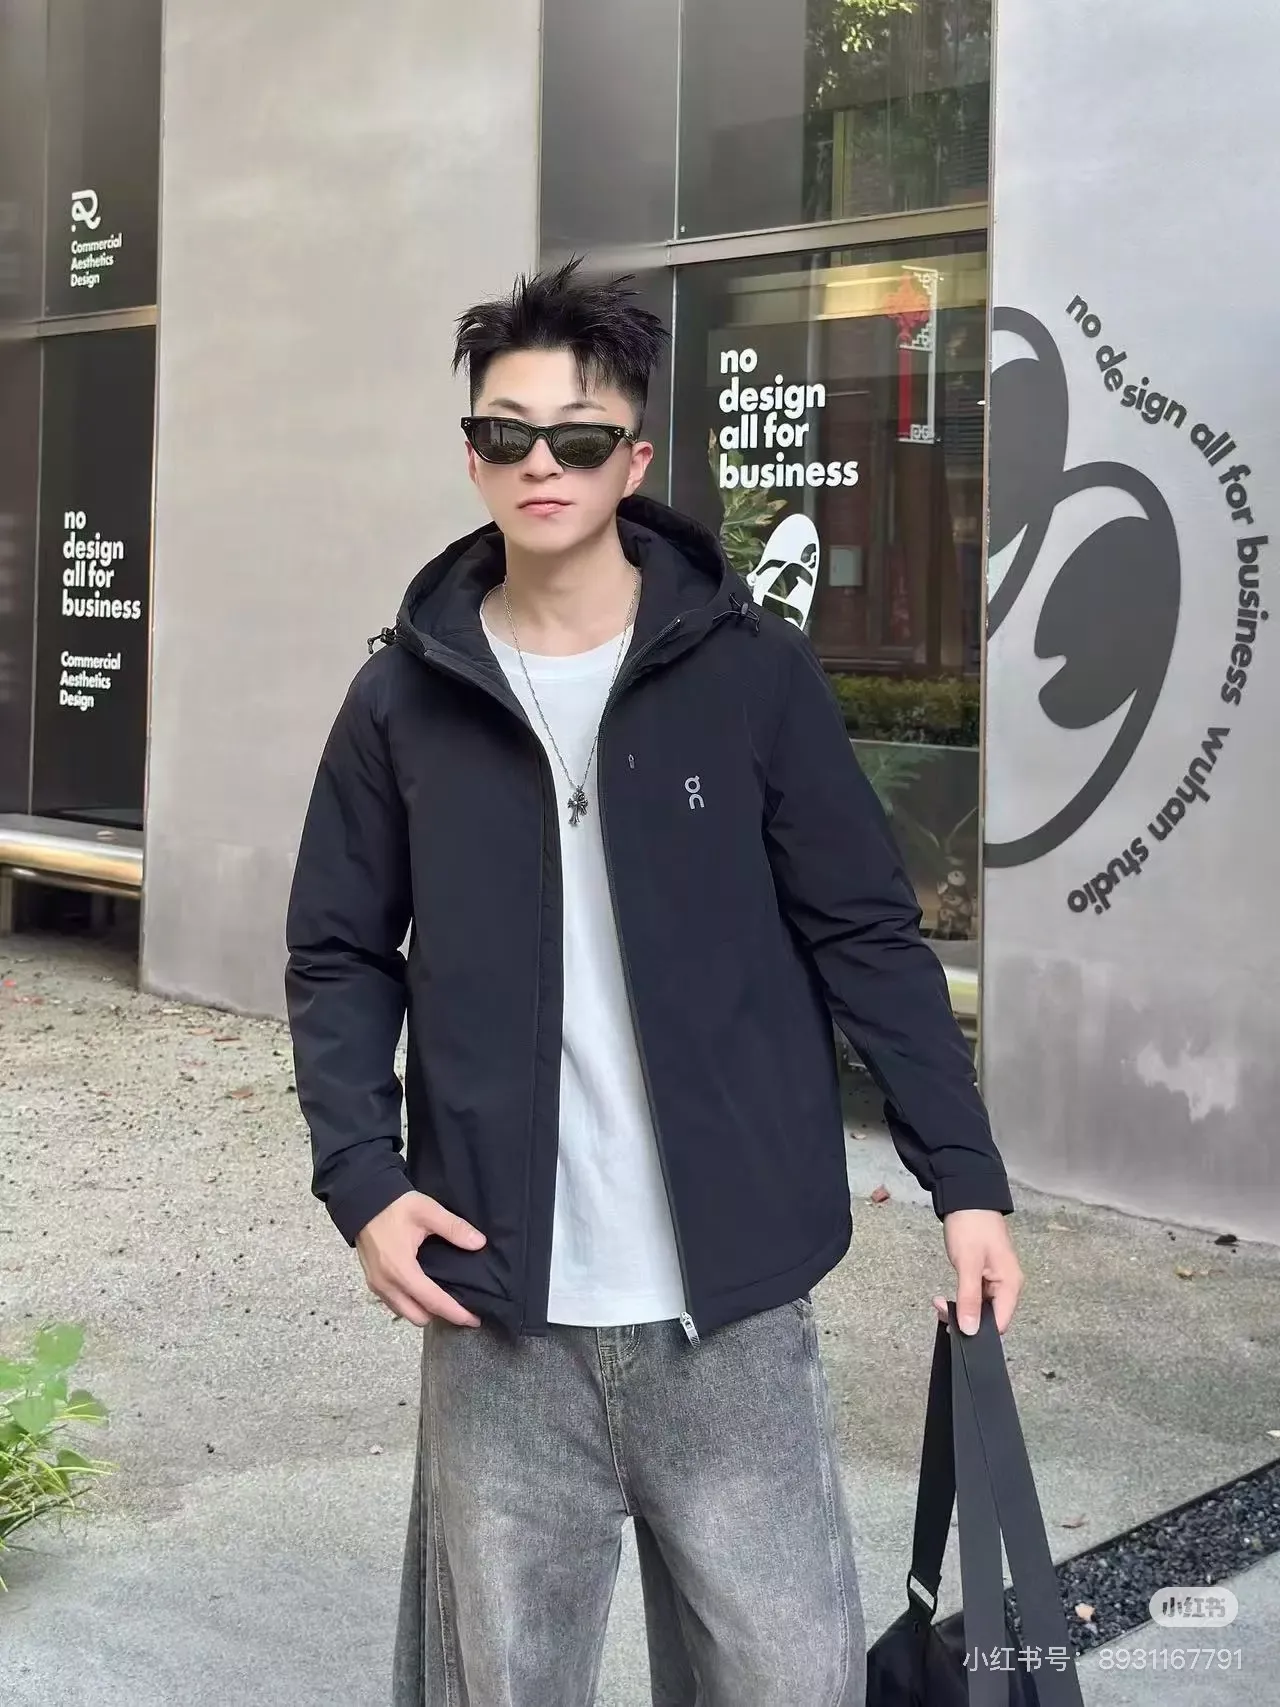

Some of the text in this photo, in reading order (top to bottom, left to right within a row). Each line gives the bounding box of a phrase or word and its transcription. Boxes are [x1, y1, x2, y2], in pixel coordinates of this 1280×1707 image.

[71, 232, 123, 255] Commercial
[70, 251, 114, 271] Aesthetics
[70, 270, 100, 288] Design
[720, 348, 758, 374] no
[719, 374, 826, 419] design
[719, 411, 810, 450] all for
[719, 452, 859, 489] business
[64, 510, 87, 530] no
[62, 531, 124, 567] design
[62, 559, 115, 589] all for
[61, 588, 141, 620] business
[1065, 294, 1269, 915] no design all for business wuhan studio
[60, 650, 122, 671] Commercial
[59, 670, 112, 690] Aesthetics
[59, 689, 95, 711] Design
